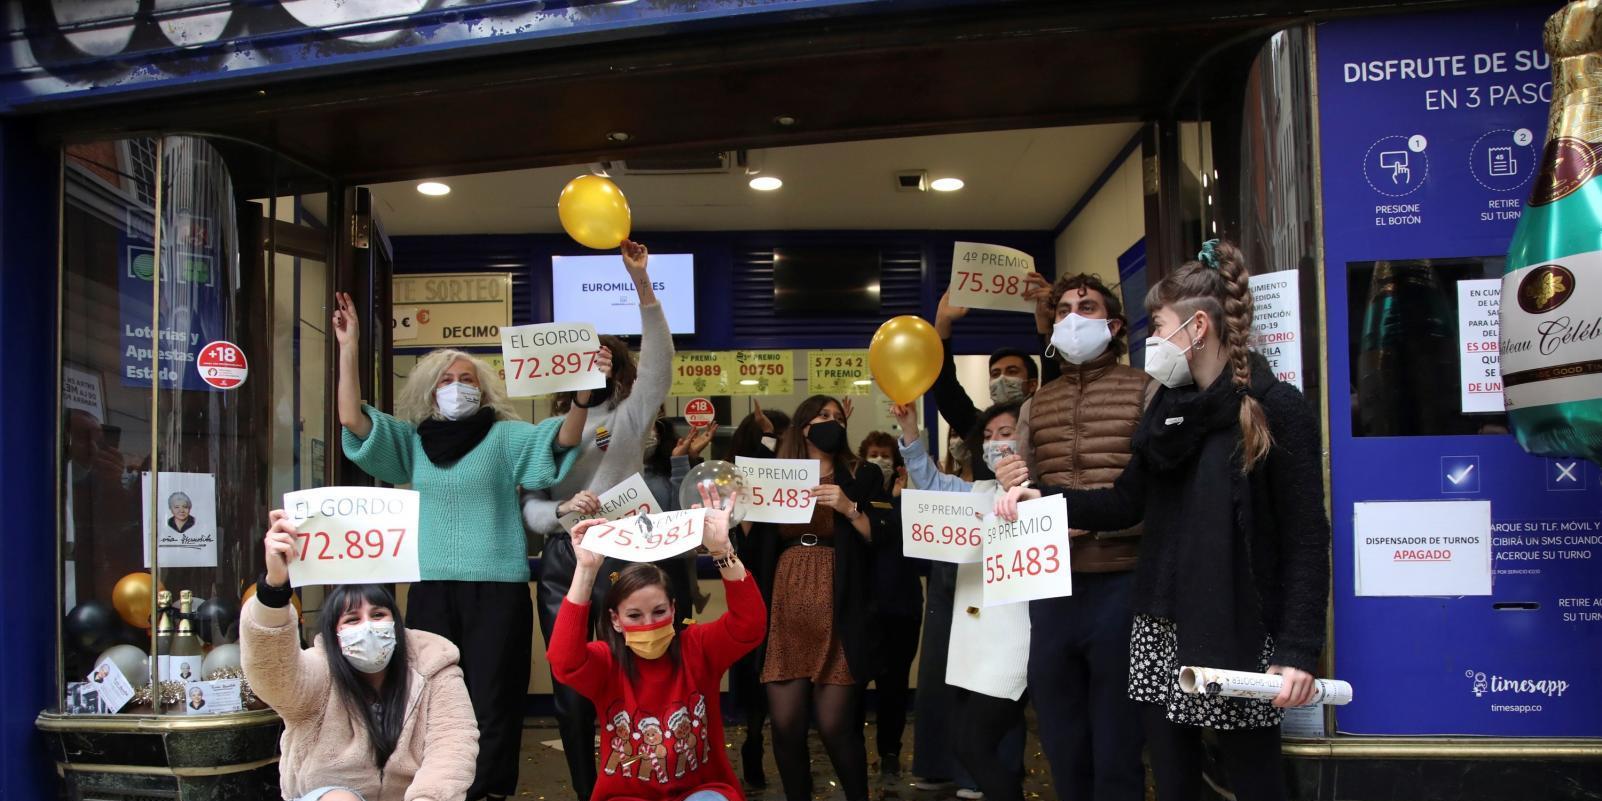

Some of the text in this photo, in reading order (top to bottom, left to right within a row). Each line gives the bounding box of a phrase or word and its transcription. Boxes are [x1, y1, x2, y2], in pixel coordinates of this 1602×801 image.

[1343, 55, 1467, 83] DISFRUTE
[1474, 52, 1507, 74] DE
[1425, 89, 1457, 111] EN
[1465, 87, 1481, 108] 3
[1519, 133, 1527, 142] 2
[1375, 204, 1420, 214] PRESIONE
[1488, 199, 1520, 208] RETIRE
[1375, 214, 1421, 226] EL BOTÓN
[1480, 212, 1494, 221] SU
[981, 252, 1029, 270] PREMIO
[425, 279, 500, 300] SORTEO
[582, 282, 665, 292] EUROMILLES
[957, 271, 1030, 297] 75.981
[1254, 292, 1281, 302] EDIDAS
[1470, 289, 1480, 297] EN
[442, 325, 499, 339] DECIMO
[190, 332, 199, 346] y
[510, 329, 591, 349] EL GORDO
[1467, 342, 1479, 351] ES
[208, 347, 237, 362] +18
[690, 354, 717, 362] PREMIO
[510, 351, 597, 380] 72.897
[677, 364, 722, 377] 10989
[740, 363, 784, 376] 00750
[126, 365, 178, 381] Estdo
[824, 369, 862, 378] PREMIO
[1485, 368, 1497, 377] SE
[1468, 383, 1482, 391] DE
[690, 401, 707, 411] +18
[758, 467, 808, 481] PREMIO
[752, 486, 811, 508] 5.483
[295, 497, 404, 520] EL GORDO
[918, 503, 974, 517] 5º PREMIO
[998, 514, 1053, 541] PREMIO
[1524, 523, 1538, 531] SU
[1560, 521, 1593, 531] MÓVIL
[1594, 522, 1601, 530] Y
[597, 518, 696, 550] 75.981
[911, 523, 982, 547] 86.986
[1366, 537, 1427, 545] DISPENSADOR
[1443, 536, 1480, 544] TURNOS
[1525, 536, 1539, 545] UN
[1541, 536, 1562, 545] SMS
[296, 528, 407, 562] 72.897
[1393, 549, 1452, 560] APAGADO
[1495, 550, 1592, 560] ACERQUE SU TURNO
[986, 544, 1060, 584] 55.483
[1558, 598, 1591, 607] RETIRE
[1563, 612, 1577, 621] SU
[1491, 675, 1570, 697] timesapp
[1491, 704, 1542, 714] timesapp.co
